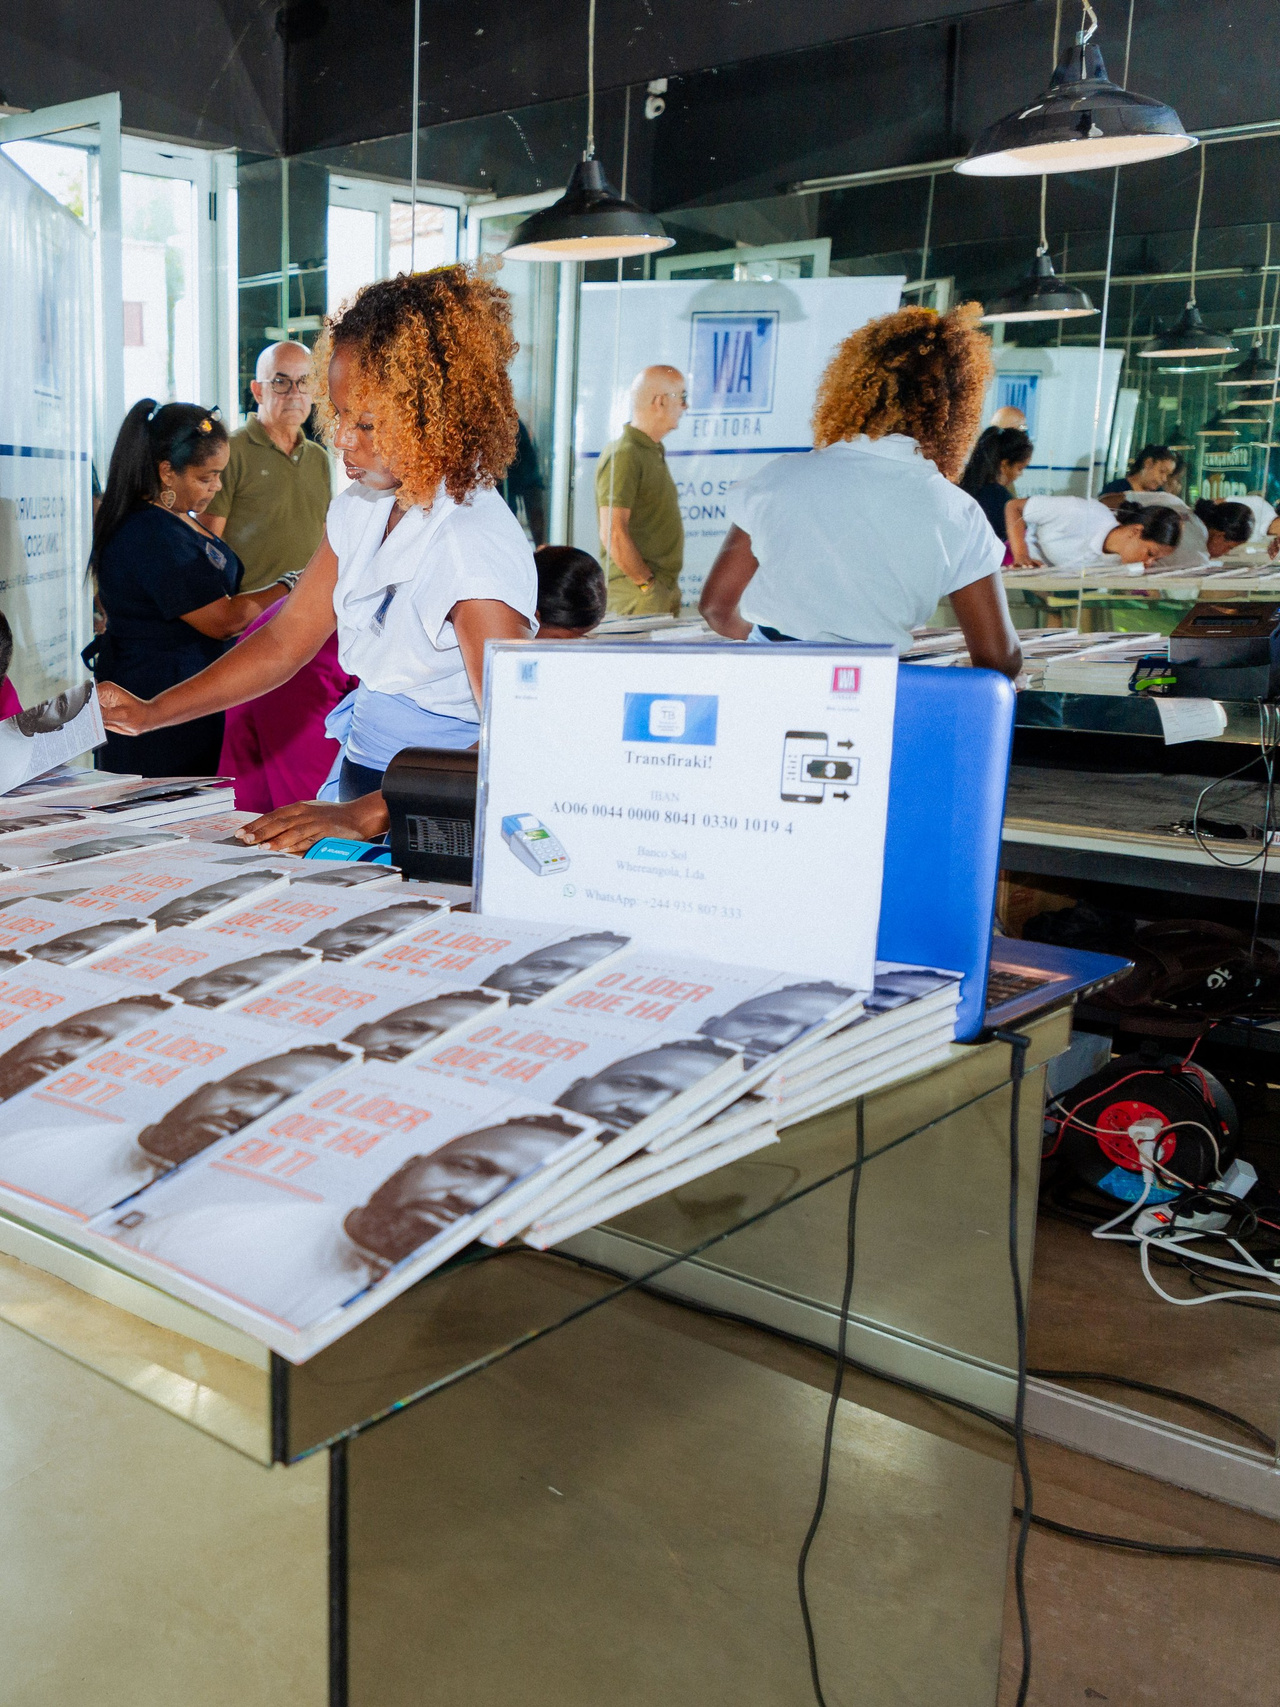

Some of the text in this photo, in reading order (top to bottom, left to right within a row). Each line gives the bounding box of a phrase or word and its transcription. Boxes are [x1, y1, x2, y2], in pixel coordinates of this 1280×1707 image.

[625, 750, 713, 770] Transfiraki!
[551, 801, 794, 834] AO06 0044 0000 8041 0330 1019 4
[637, 845, 687, 860] Banco Sol
[224, 912, 276, 929] QUE
[254, 898, 339, 920] O LÍDER
[383, 945, 442, 965] QUE
[412, 930, 511, 955] O LÍDER
[276, 981, 377, 1010] O LÍDER
[565, 990, 634, 1013] QUE
[595, 972, 627, 988] O
[620, 975, 714, 1002] LÍDER
[242, 998, 302, 1018] QUE
[125, 1030, 159, 1047] O
[145, 1034, 227, 1066] LÍDER
[468, 1026, 502, 1043] O
[492, 1030, 589, 1061] LÍDER
[86, 1051, 149, 1077] QUE
[431, 1045, 503, 1072] QUE
[490, 1057, 553, 1083] HÁ
[44, 1072, 126, 1106] EM TI
[310, 1089, 347, 1110] O
[334, 1093, 432, 1134] LÍDER
[268, 1114, 392, 1159] QUE HÁ
[224, 1138, 318, 1177] EM TI
